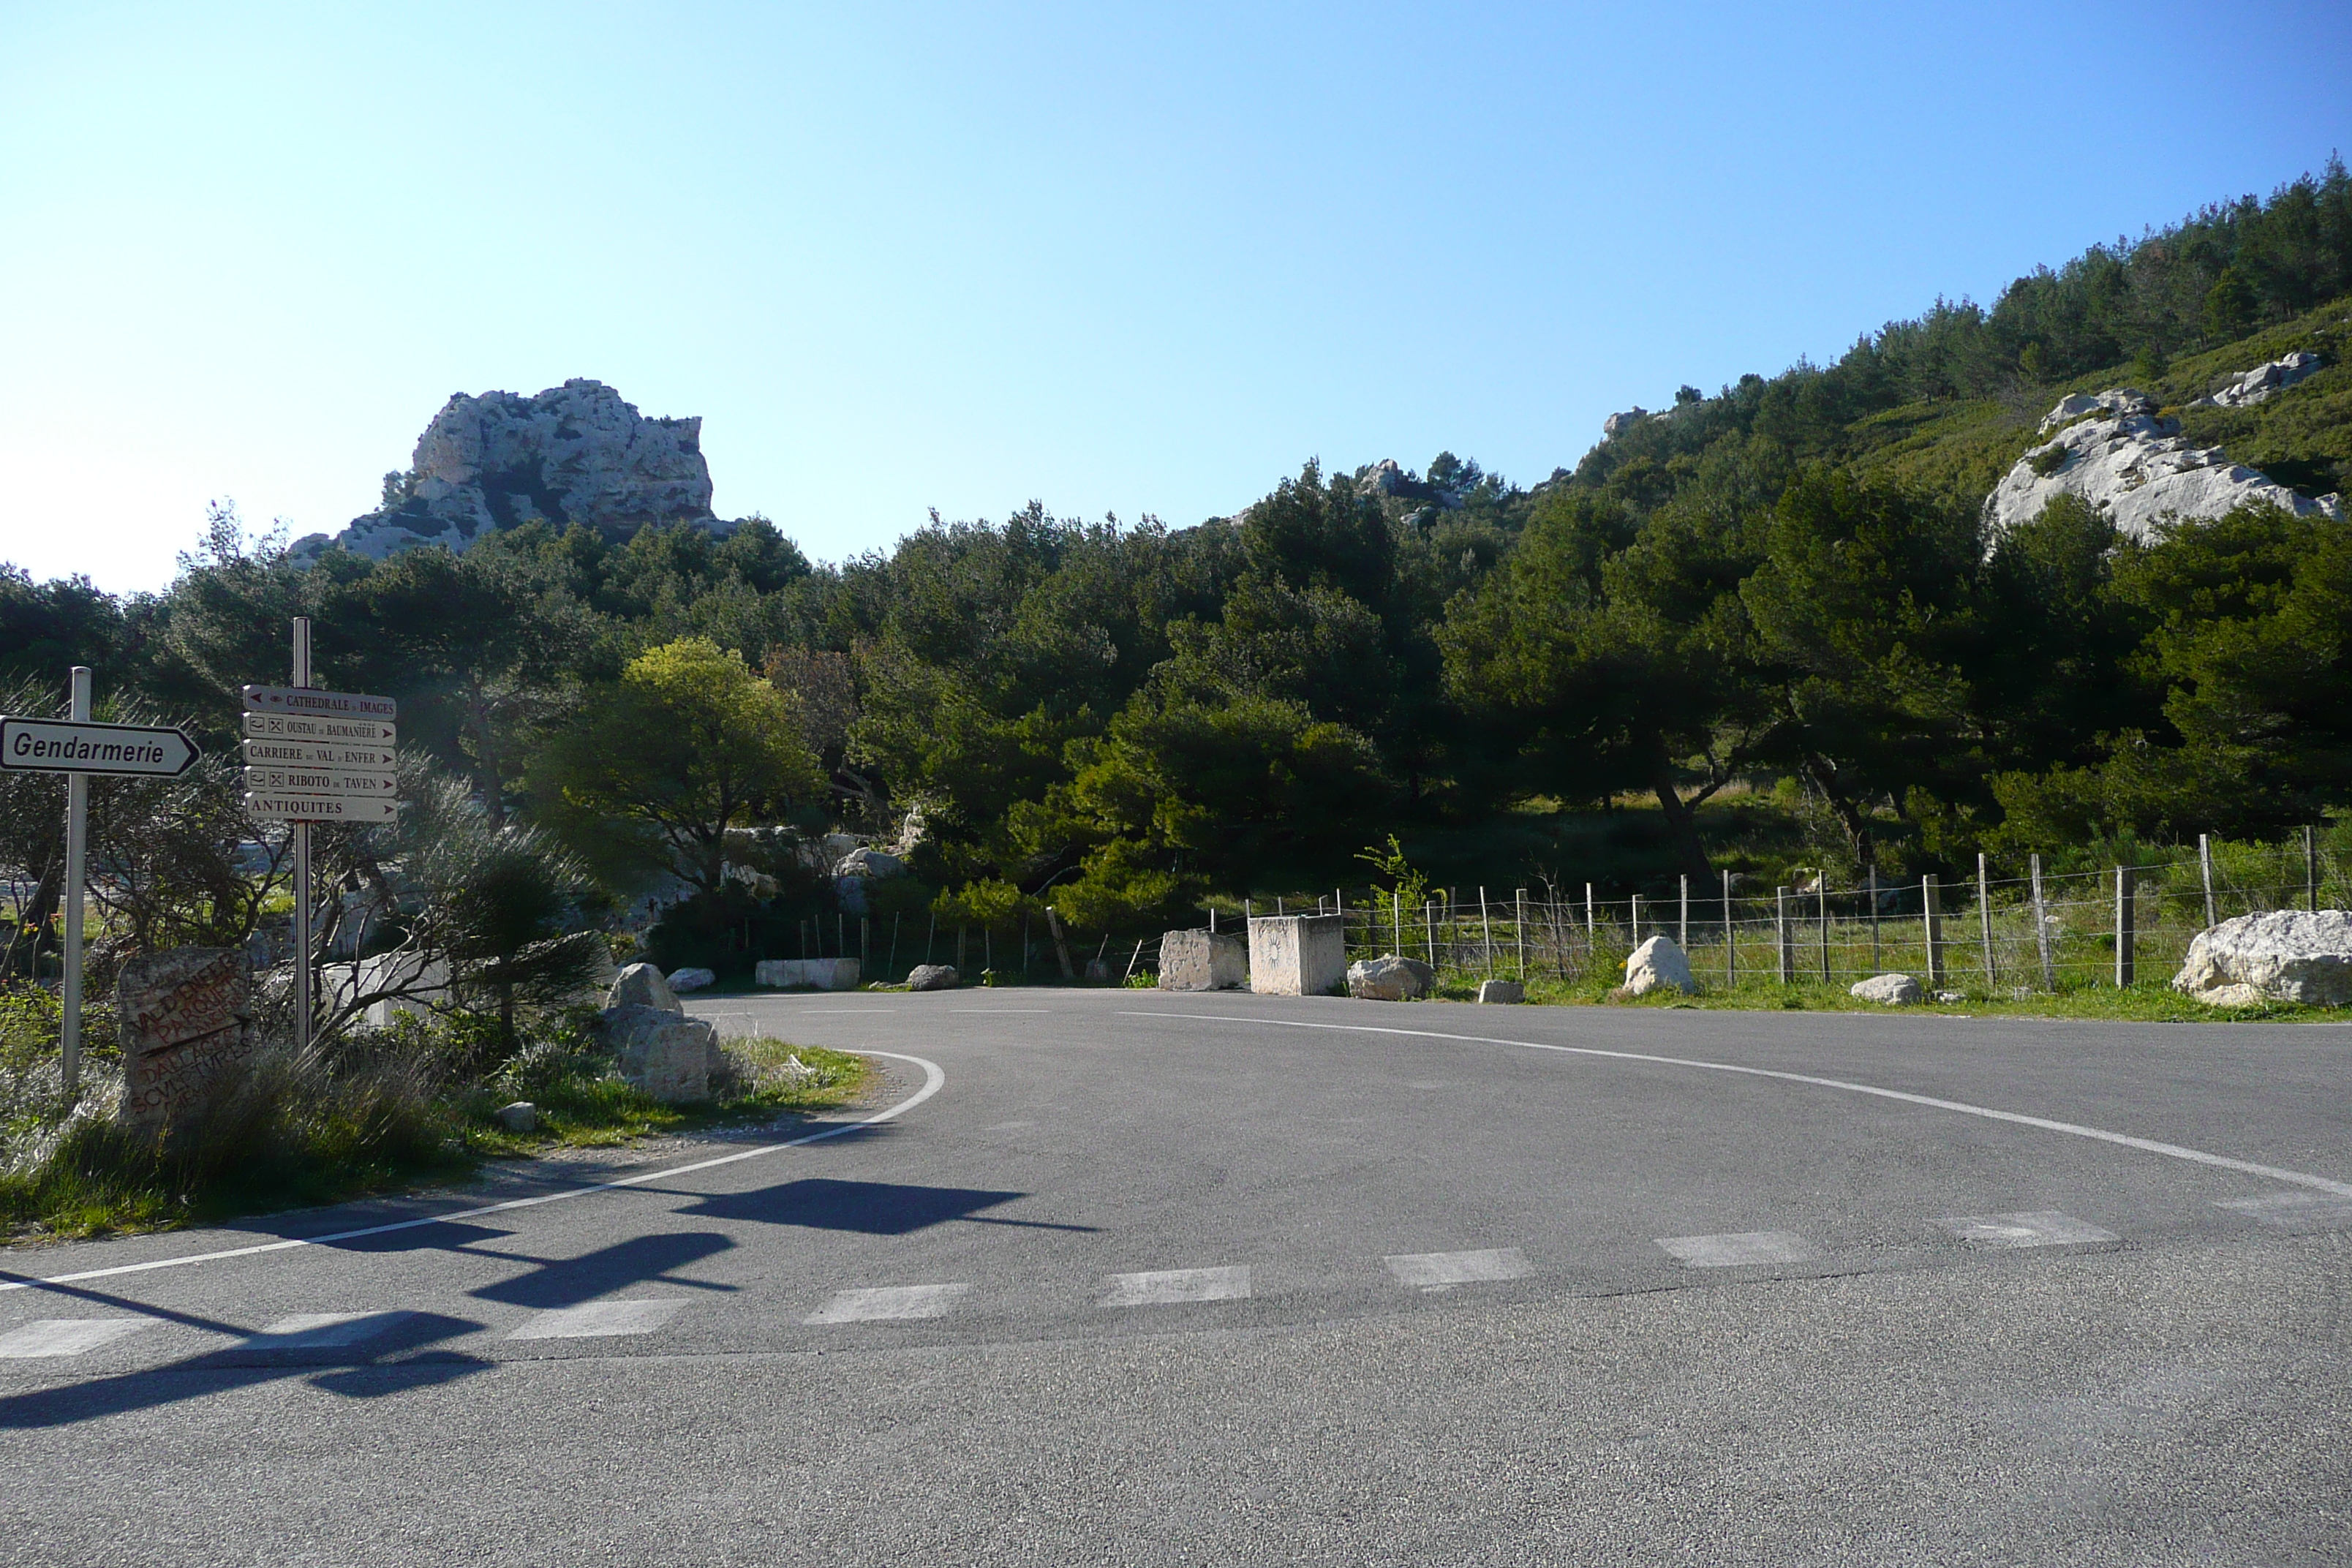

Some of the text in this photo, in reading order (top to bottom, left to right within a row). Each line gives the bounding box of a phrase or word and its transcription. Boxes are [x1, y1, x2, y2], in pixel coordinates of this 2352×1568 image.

[287, 695, 349, 711] CATHEDRALE
[287, 721, 317, 734] OUSTAU
[14, 732, 163, 763] Gendarmerie
[250, 745, 302, 760] CARRIERE
[317, 750, 334, 761] VAL
[288, 774, 329, 788] RIBOTO
[344, 777, 377, 789] TAVEN
[252, 799, 342, 814] ANTIQUITES
